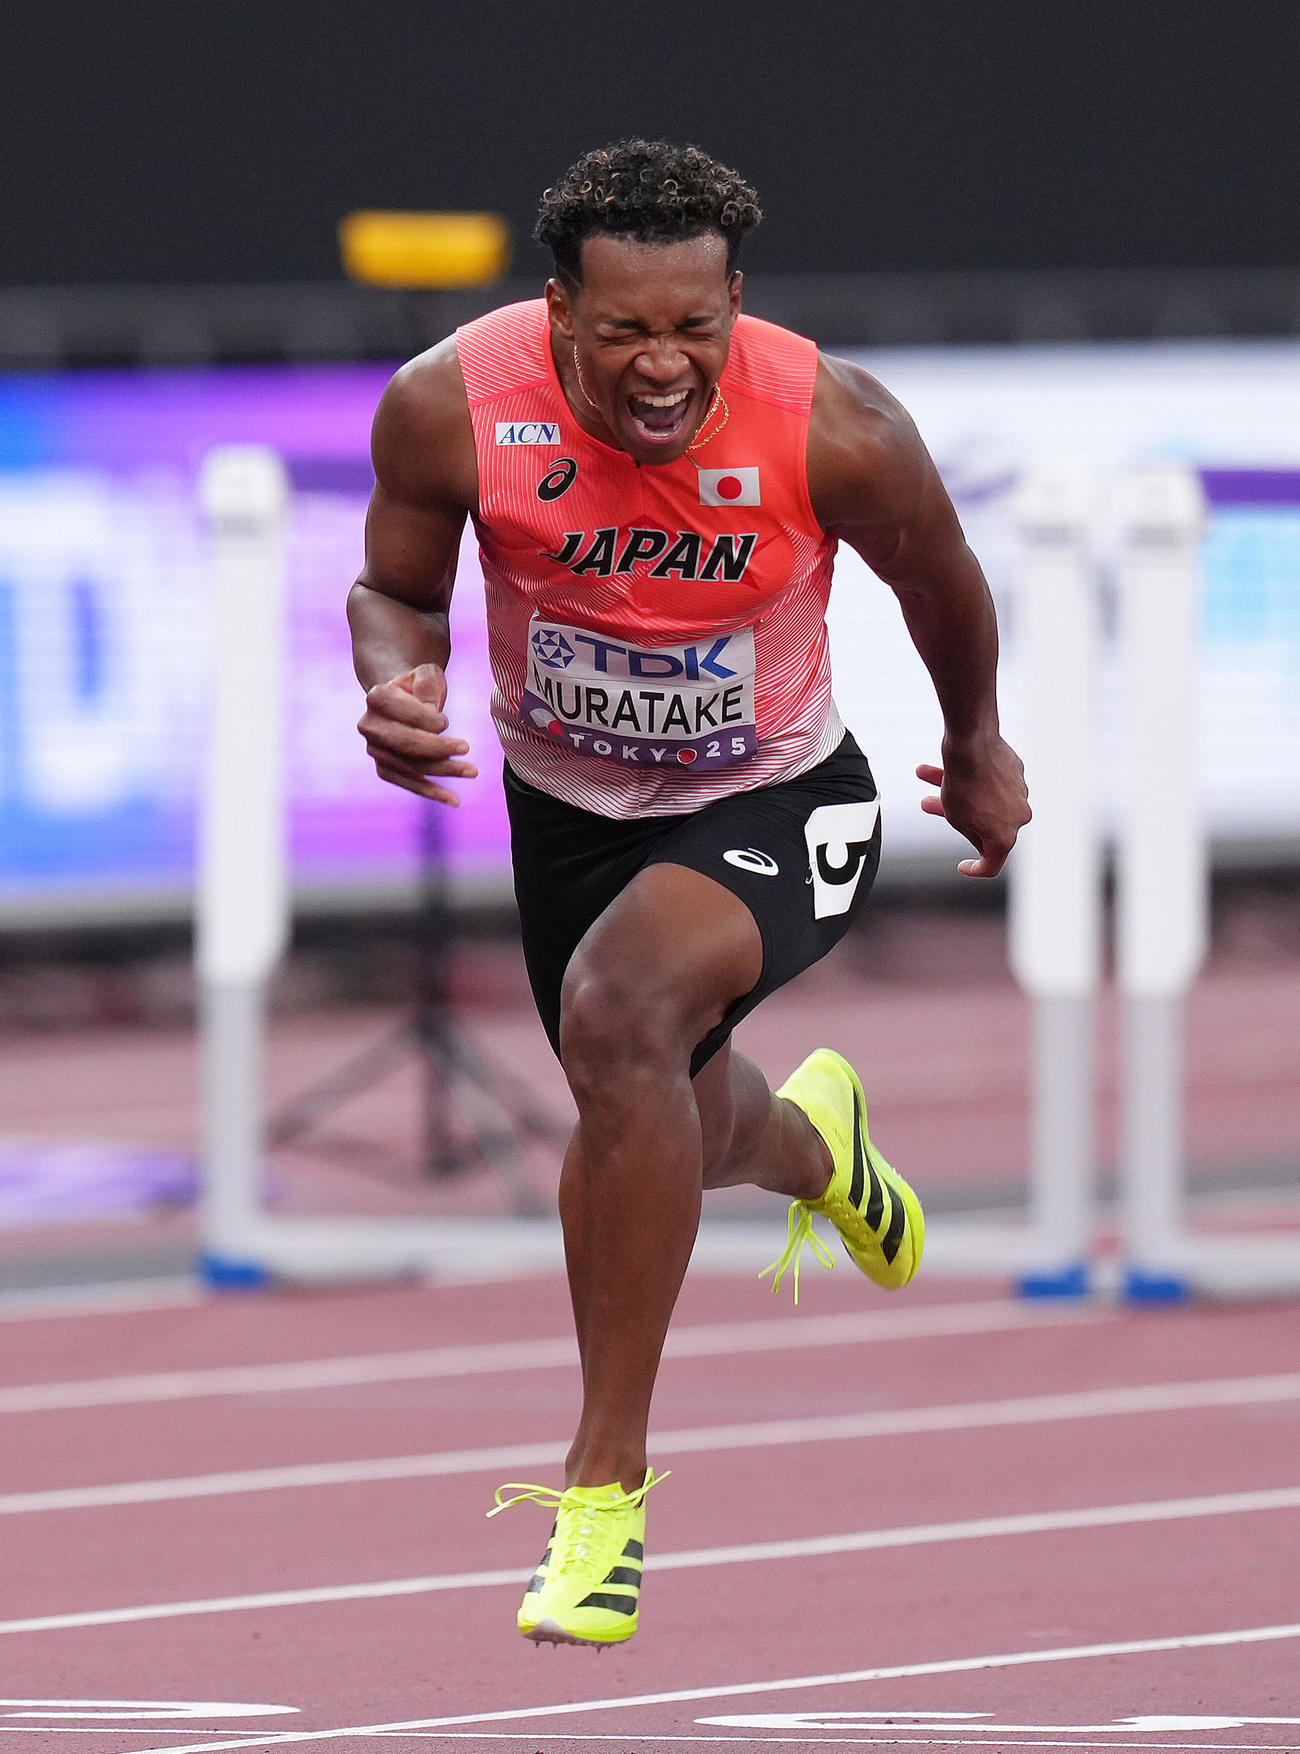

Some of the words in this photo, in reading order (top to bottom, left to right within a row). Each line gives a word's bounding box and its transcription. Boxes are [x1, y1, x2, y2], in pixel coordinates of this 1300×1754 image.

[500, 423, 557, 444] ACN
[538, 526, 758, 582] JAPAN
[574, 634, 738, 682] TDK
[533, 660, 744, 735] MURATAKE
[706, 736, 746, 759] 25
